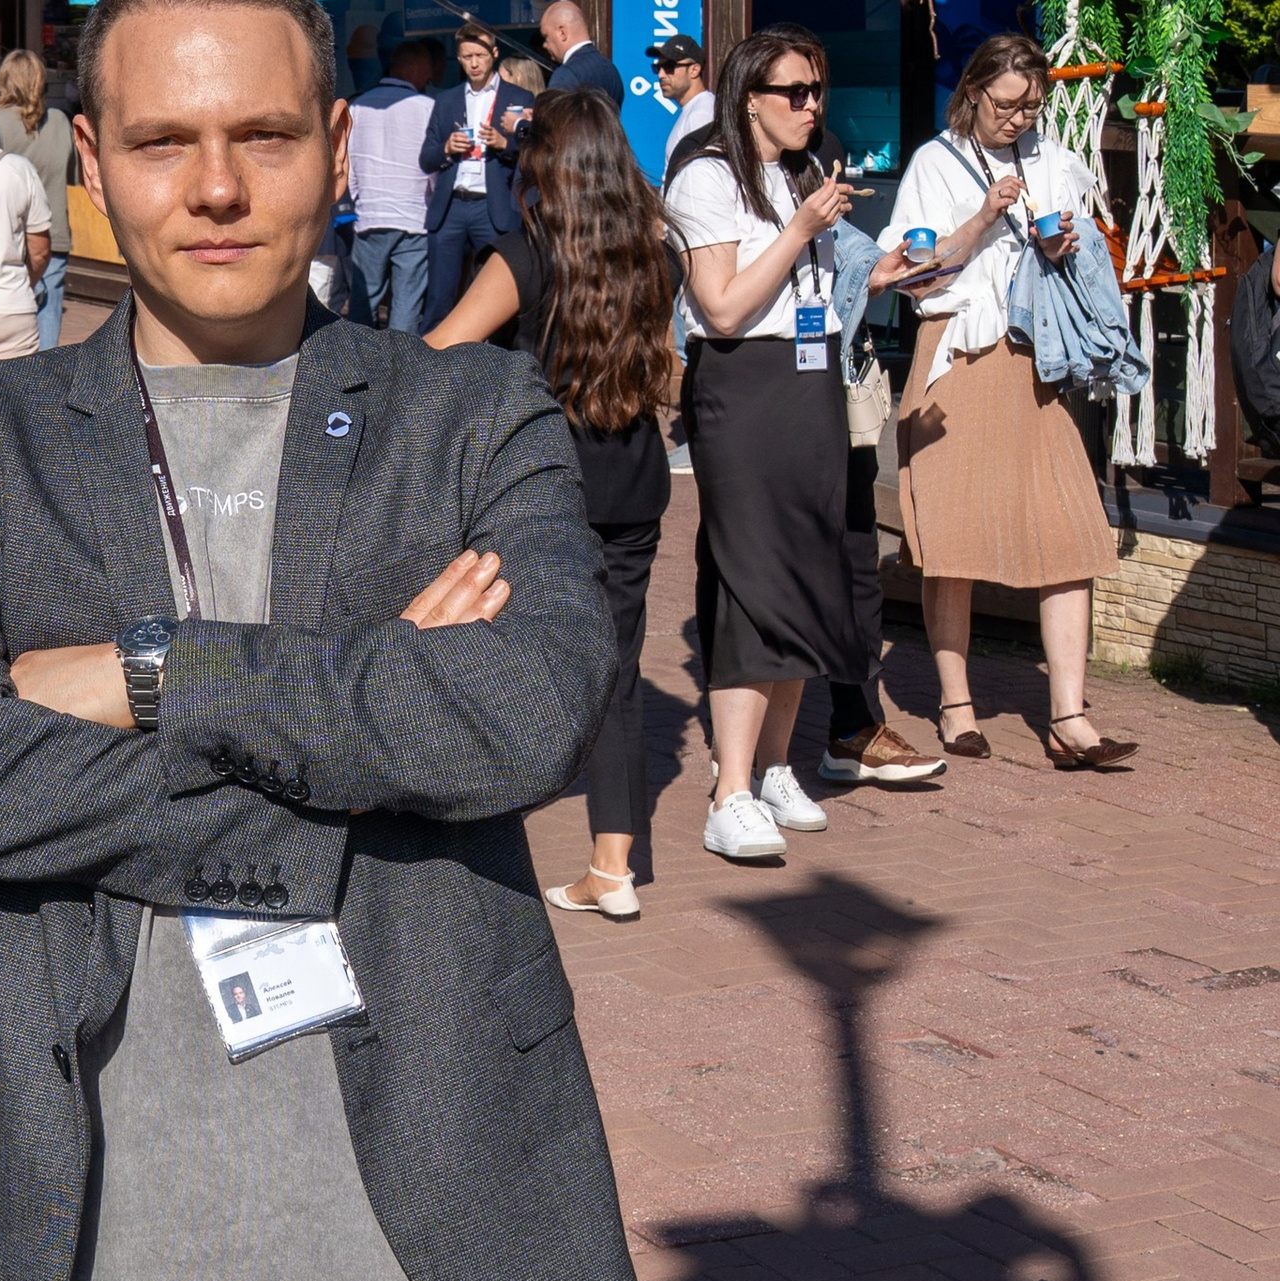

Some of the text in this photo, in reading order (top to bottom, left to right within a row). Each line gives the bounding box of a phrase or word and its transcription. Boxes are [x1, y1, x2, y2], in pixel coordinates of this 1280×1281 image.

[160, 475, 176, 516] ДВИЖЕНИЕ
[263, 978, 293, 994] Алексей
[266, 989, 296, 1003] Ковалев
